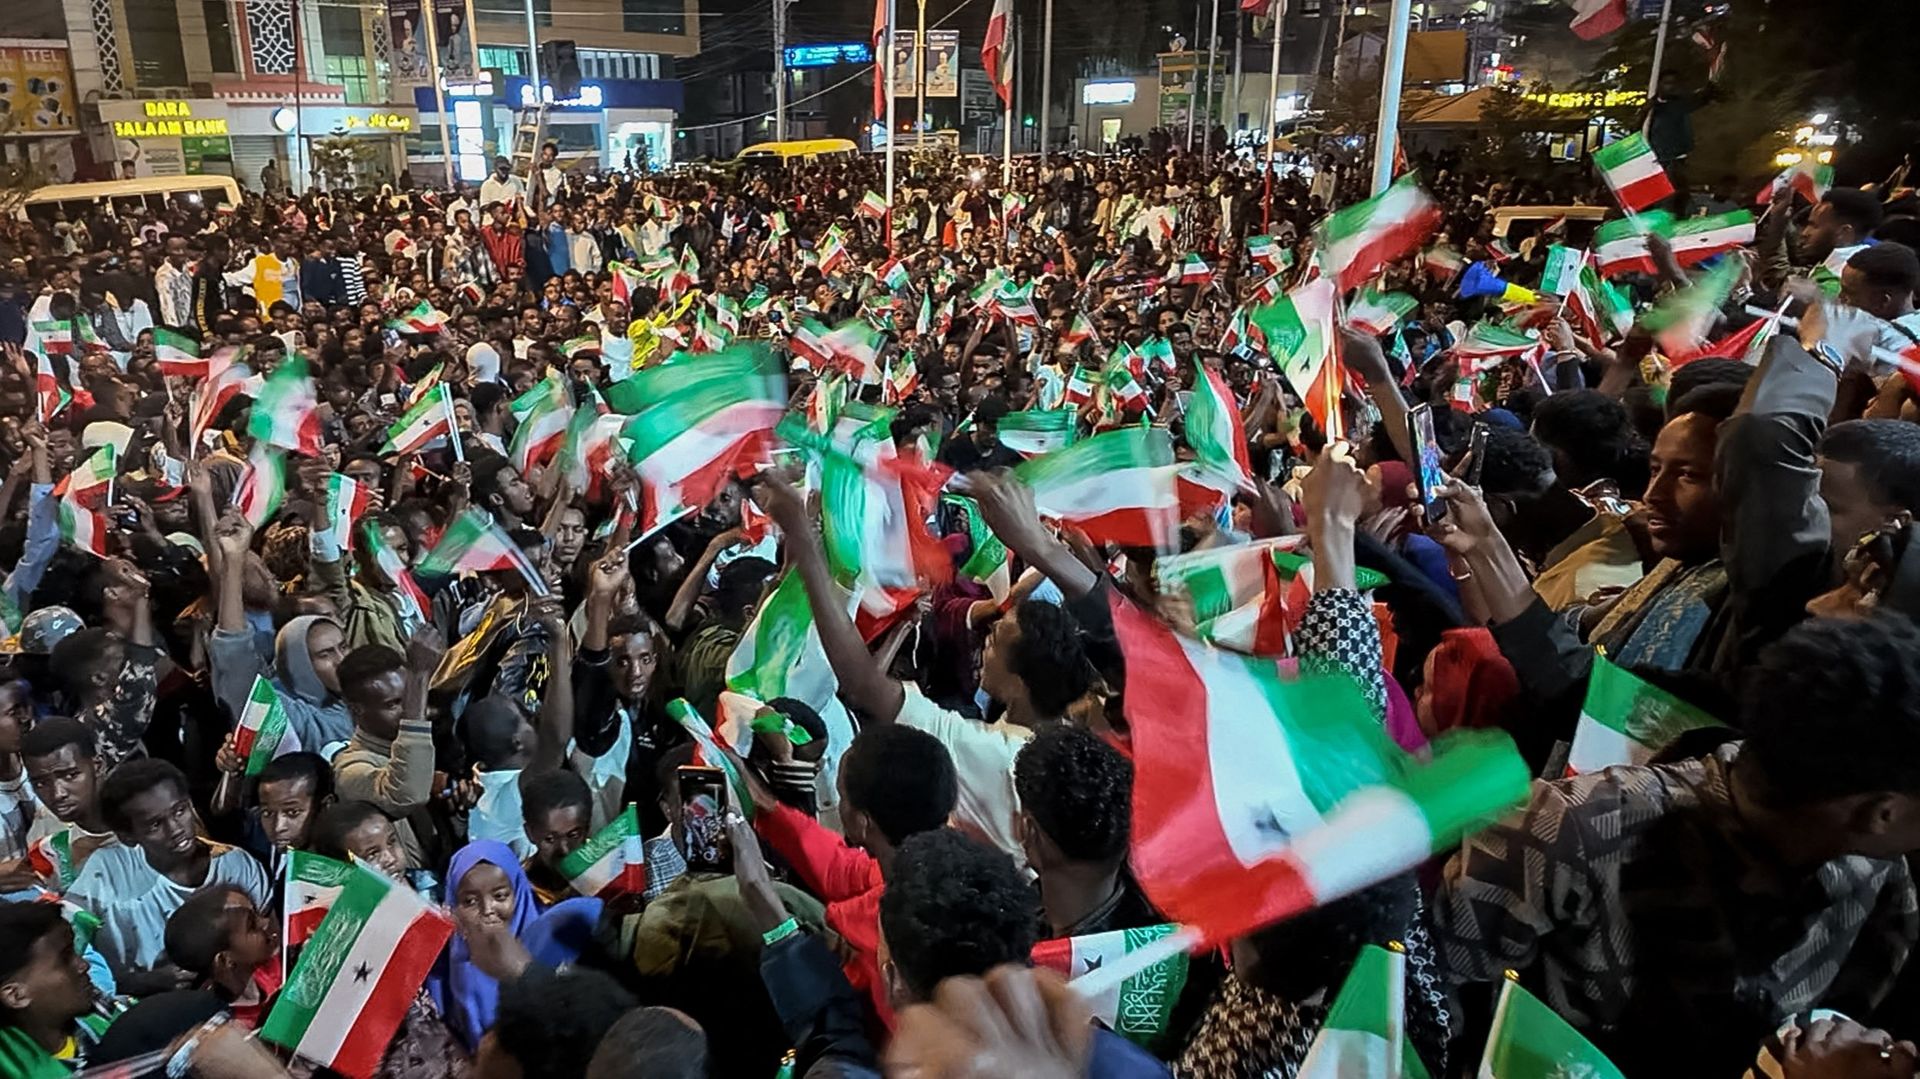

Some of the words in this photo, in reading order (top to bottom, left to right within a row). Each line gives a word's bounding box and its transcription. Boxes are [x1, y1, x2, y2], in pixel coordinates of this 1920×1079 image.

[145, 101, 191, 117] DARA
[114, 120, 182, 136] SALAAM
[183, 119, 227, 135] BANK
